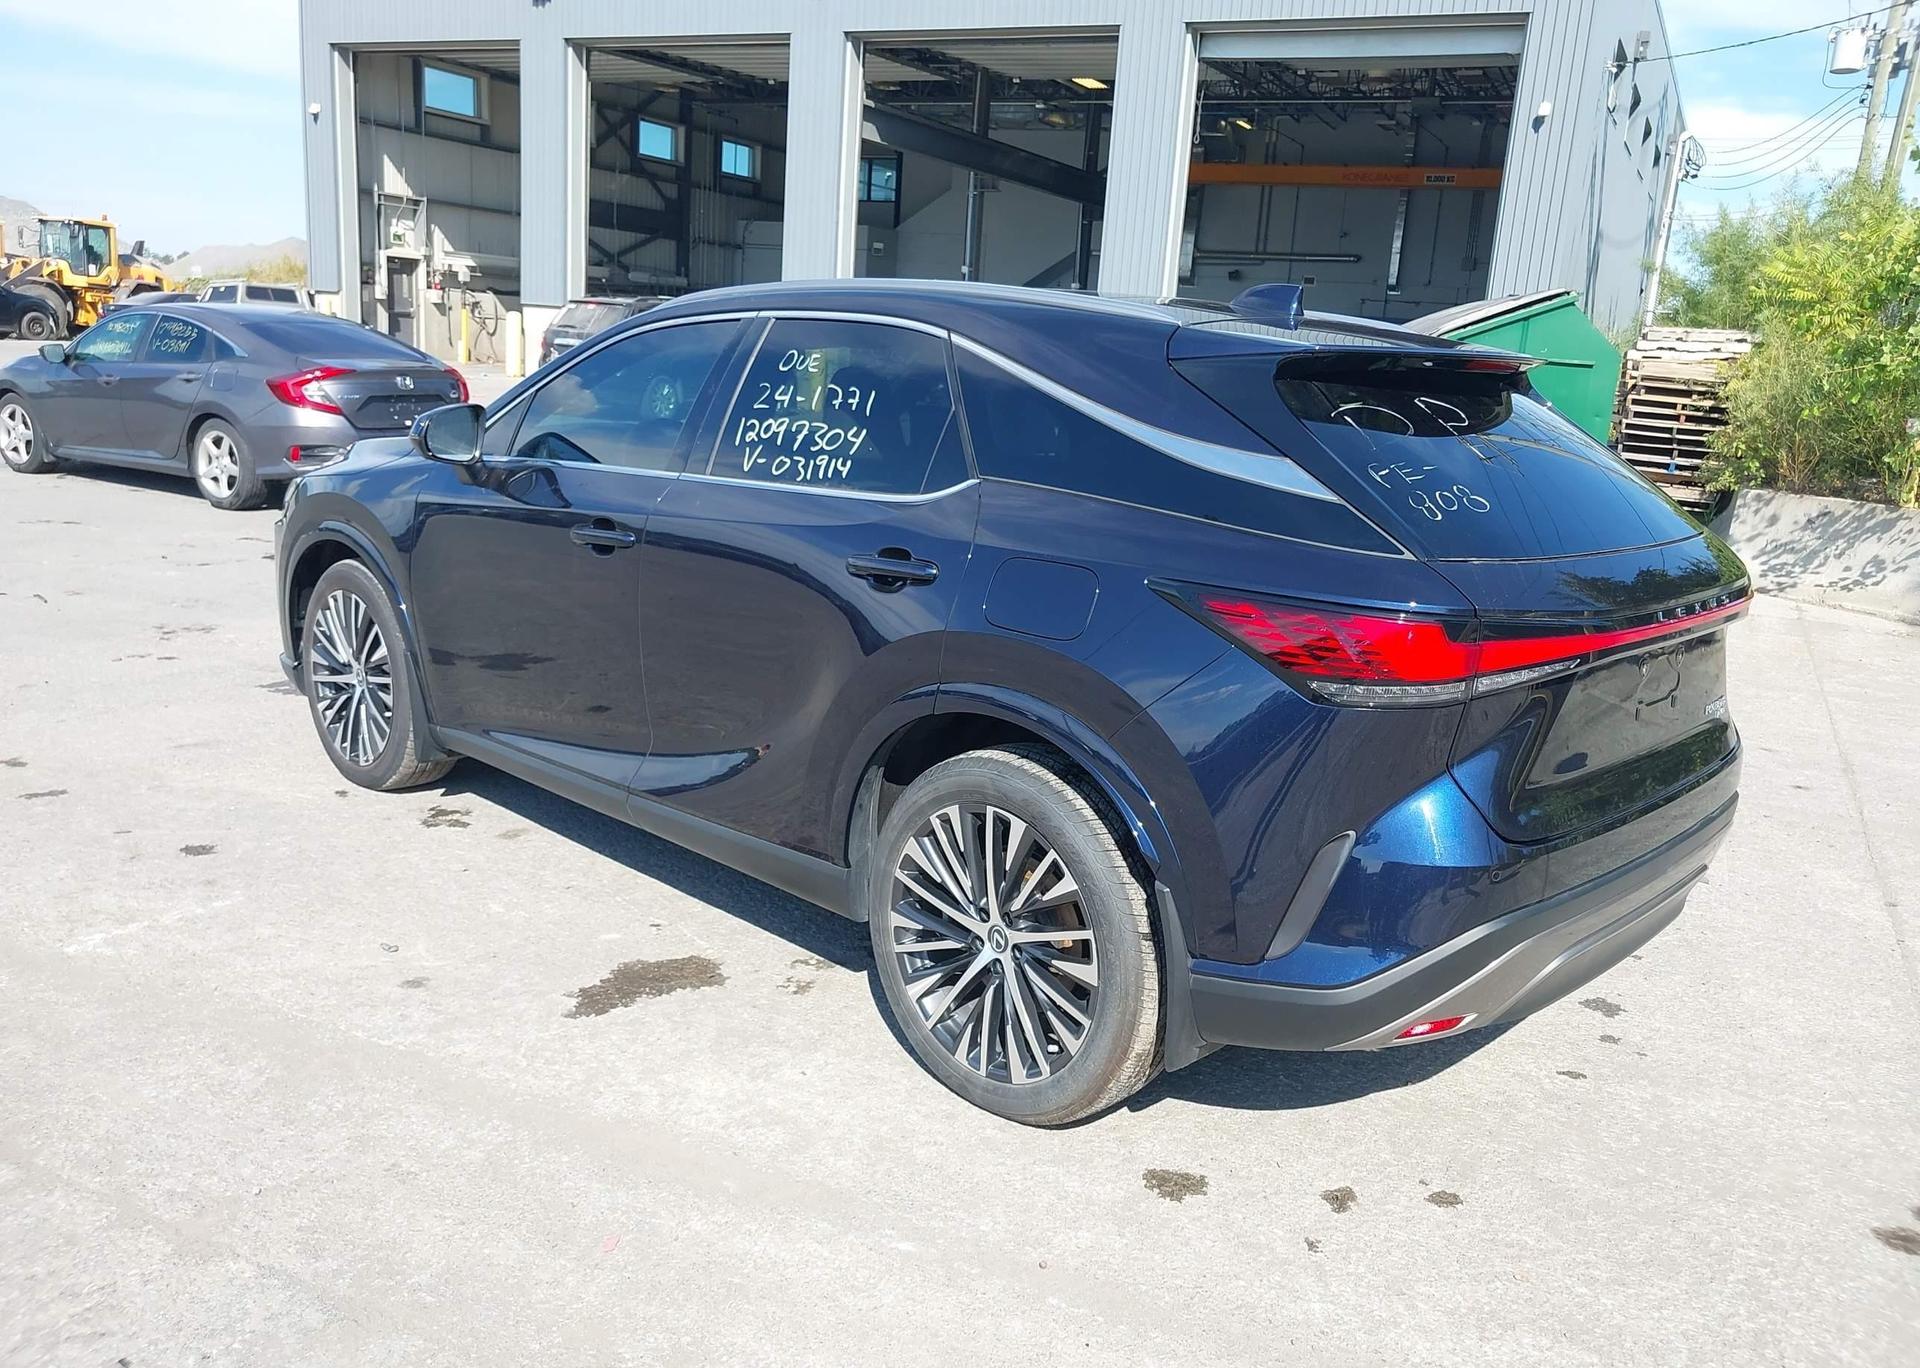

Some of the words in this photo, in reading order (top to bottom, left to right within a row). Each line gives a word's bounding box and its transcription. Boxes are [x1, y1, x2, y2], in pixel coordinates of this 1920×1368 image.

[753, 383, 876, 416] 24-1771
[743, 445, 852, 481] V-031914
[1408, 484, 1491, 521] 808
[1656, 594, 1731, 622] LEXUS
